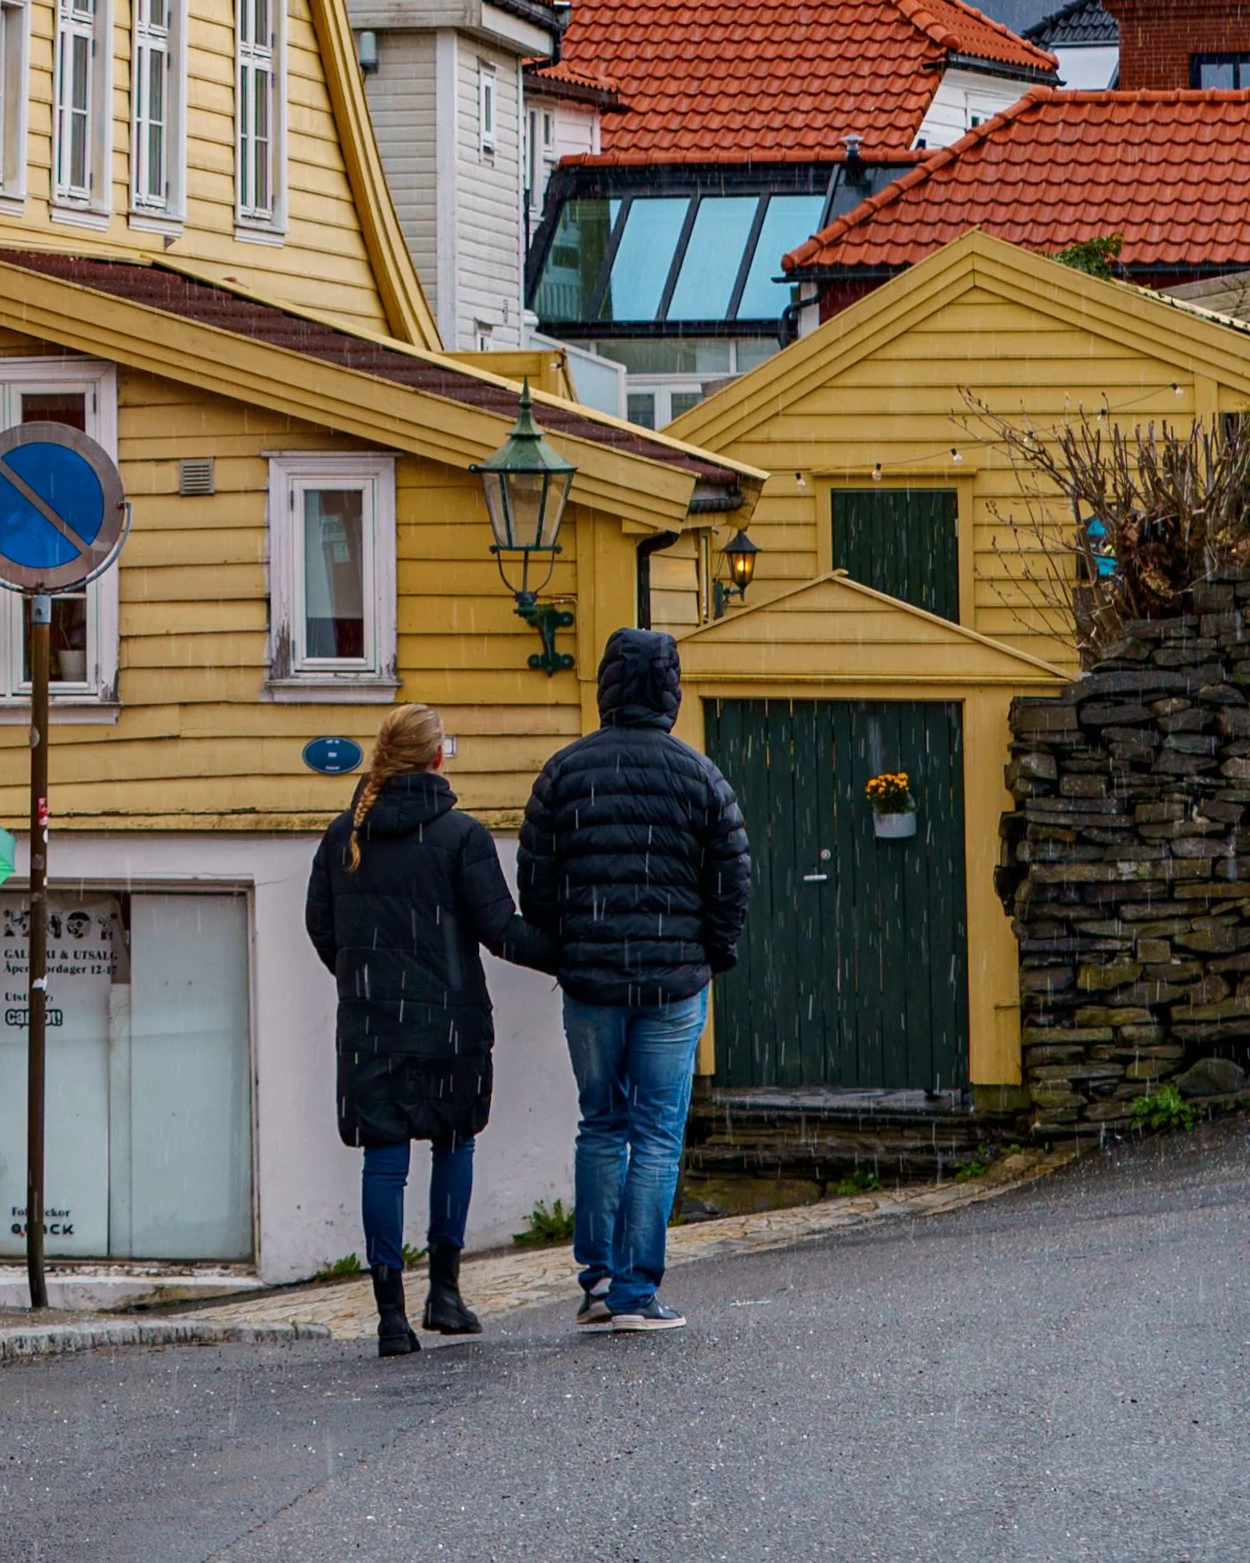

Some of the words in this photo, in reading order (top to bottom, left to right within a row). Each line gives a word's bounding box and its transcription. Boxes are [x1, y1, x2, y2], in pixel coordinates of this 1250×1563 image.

[4, 949, 56, 960] GALI
[60, 949, 70, 960] &
[73, 949, 119, 961] UTSALG
[3, 960, 30, 975] Åpe
[45, 963, 87, 975] rdager
[90, 965, 118, 975] 12-17
[5, 992, 54, 1002] Utstr:
[11, 1223, 74, 1237] QCK
